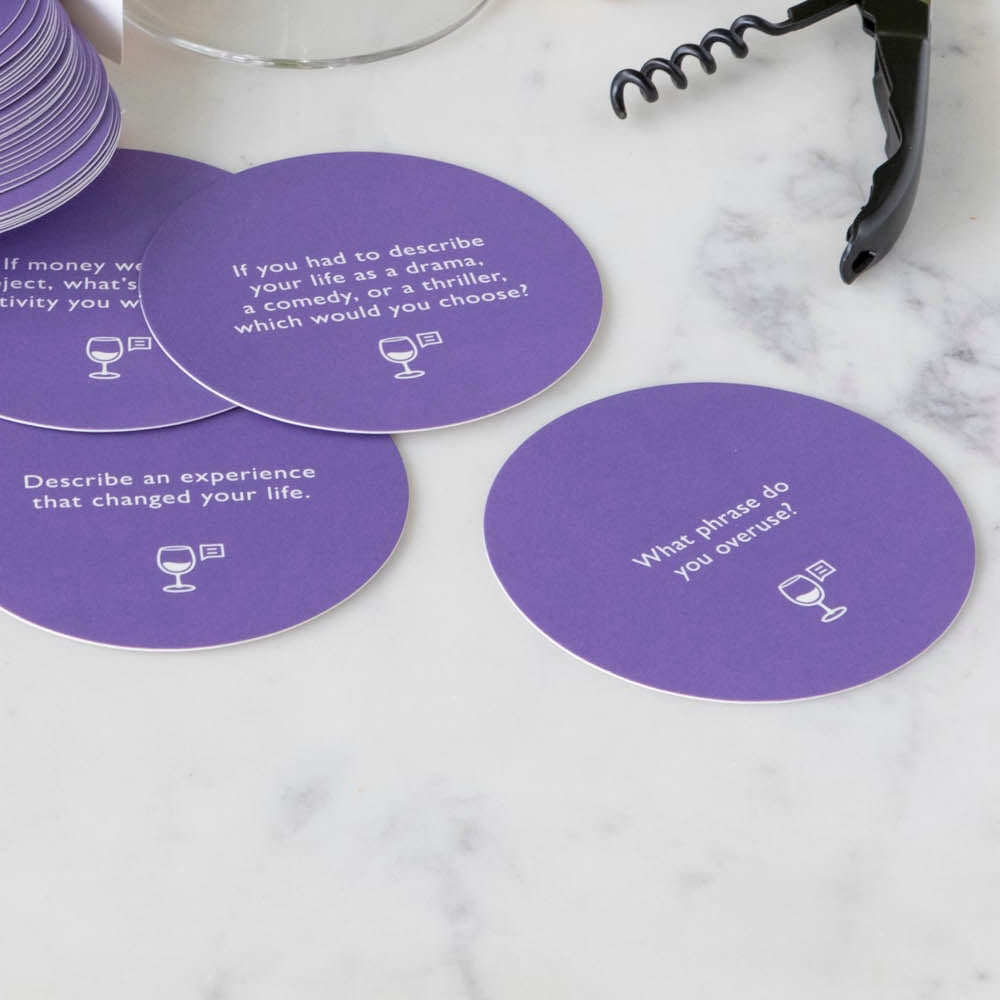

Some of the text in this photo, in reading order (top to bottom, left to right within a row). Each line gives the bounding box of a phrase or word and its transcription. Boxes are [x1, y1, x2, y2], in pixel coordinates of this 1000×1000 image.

[4, 257, 21, 271] If
[28, 261, 106, 275] money
[232, 235, 485, 279] If you had to describe
[249, 255, 485, 298] your life as a drama,
[63, 277, 138, 291] what's
[68, 299, 110, 312] you
[242, 269, 508, 315] a comedy, or a thriller,
[233, 283, 530, 335] which would you choose?
[23, 466, 316, 490] Describe an experience
[32, 485, 311, 510] that changed your life.
[631, 481, 790, 569] What phrase do
[673, 501, 798, 583] you overuse?
